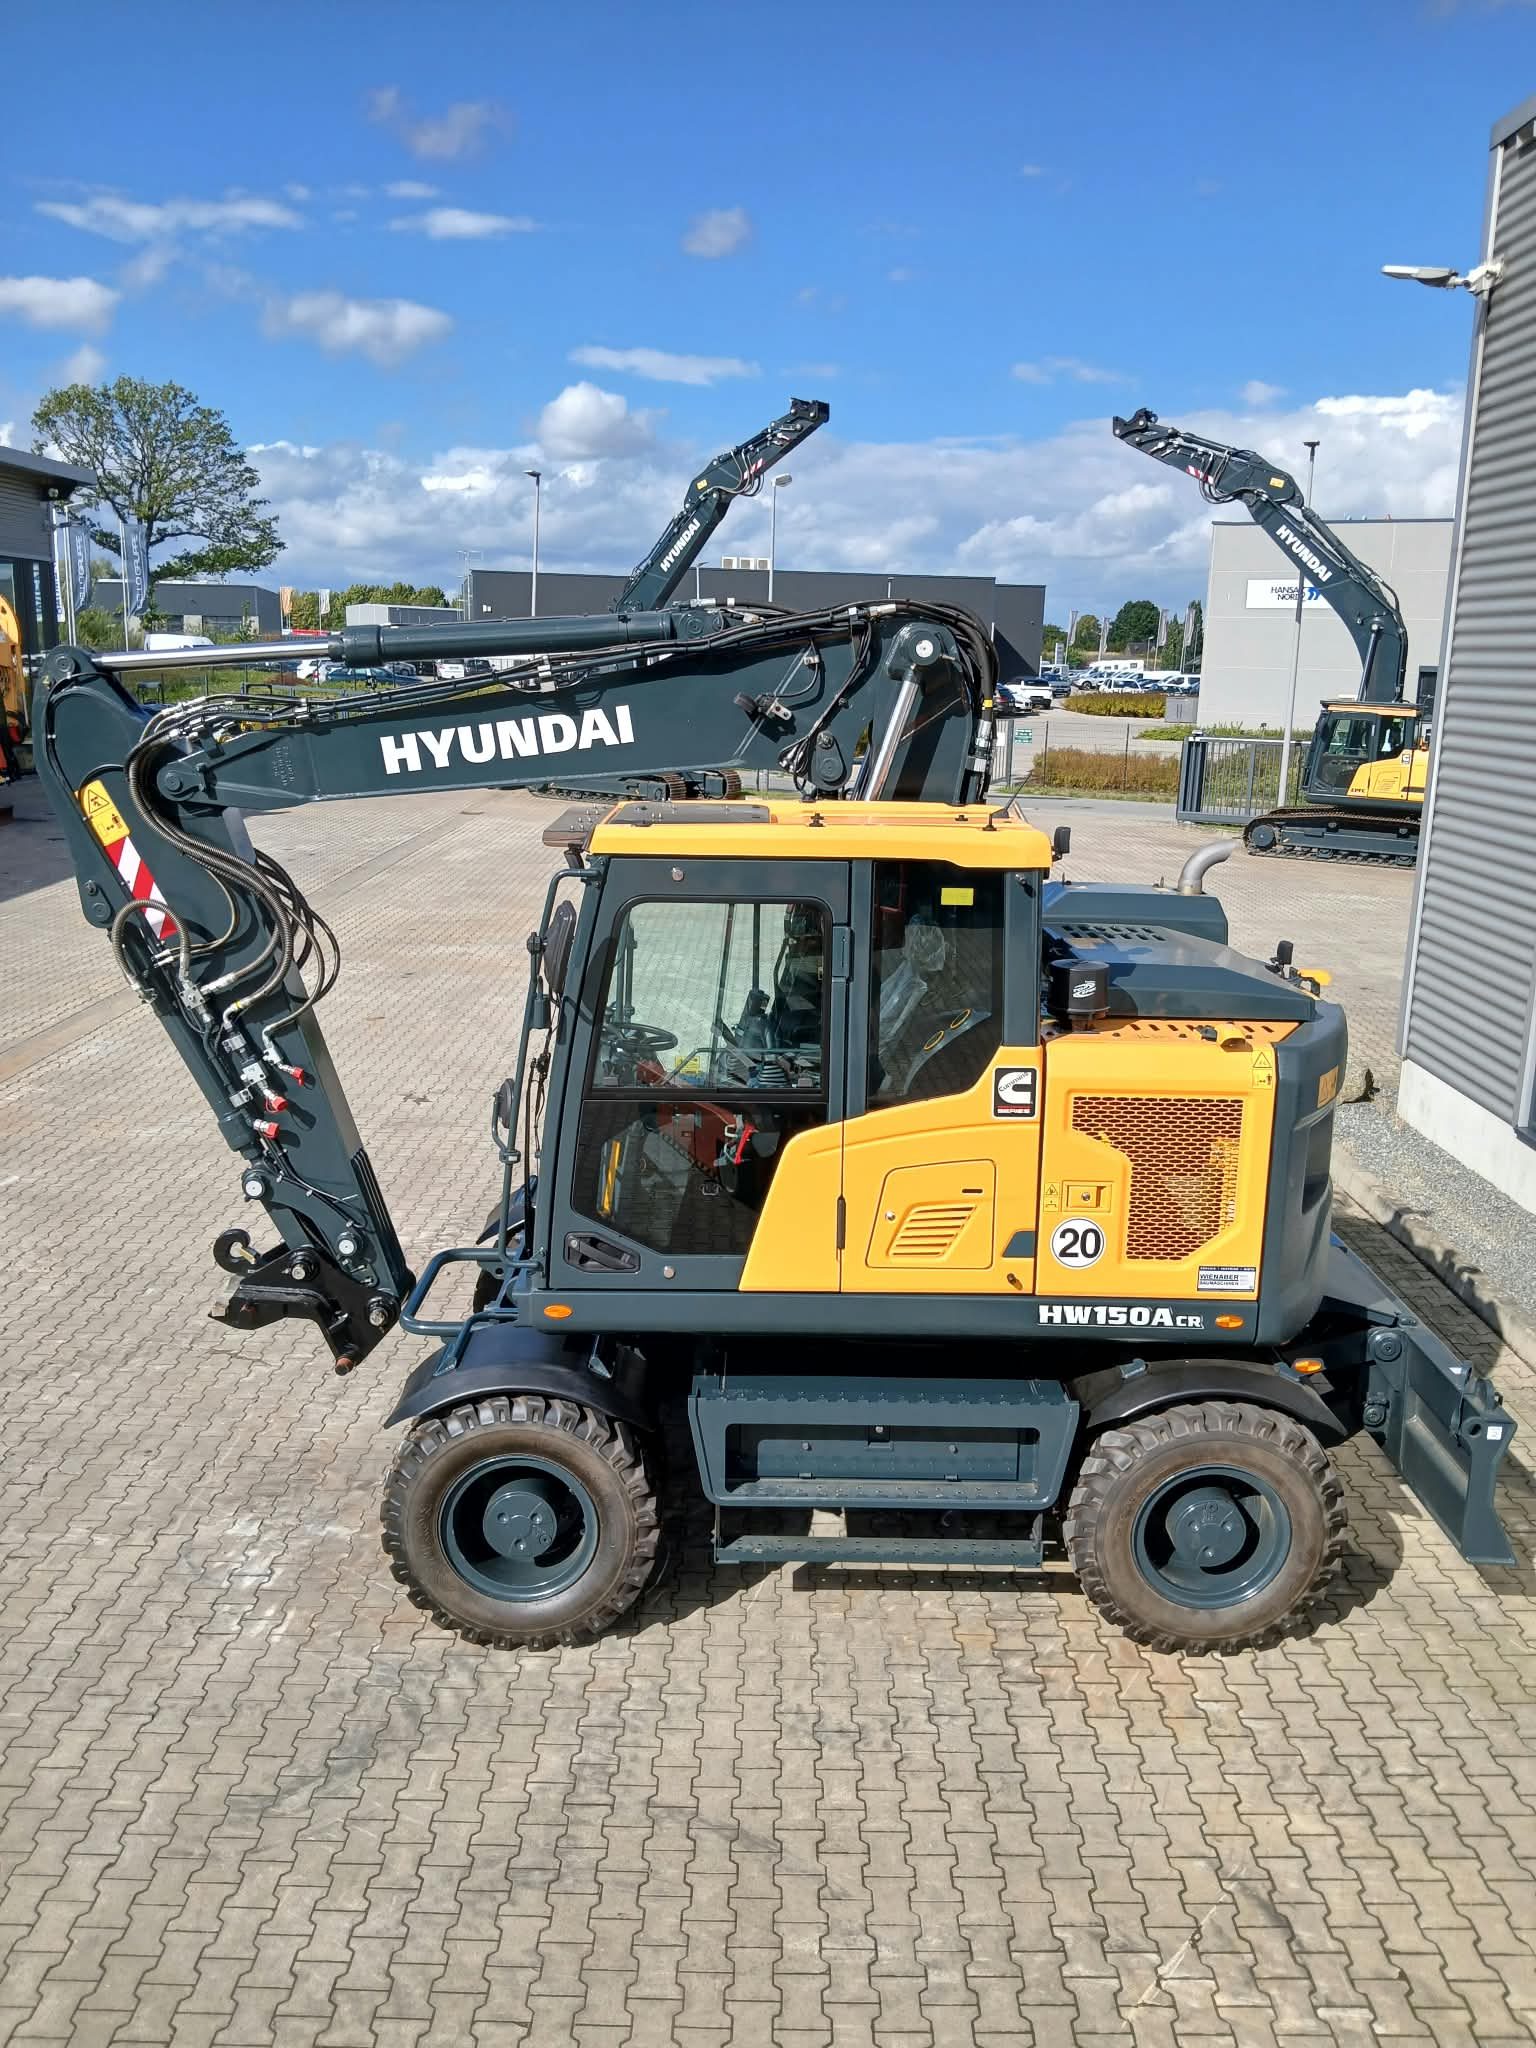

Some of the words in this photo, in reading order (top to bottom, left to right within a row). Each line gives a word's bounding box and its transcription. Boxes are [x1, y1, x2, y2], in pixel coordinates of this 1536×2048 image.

[660, 518, 700, 572] HYUNDAI
[1276, 524, 1332, 582] HYUNDAI
[380, 704, 634, 774] HYUNDAI
[1058, 1227, 1101, 1259] 20
